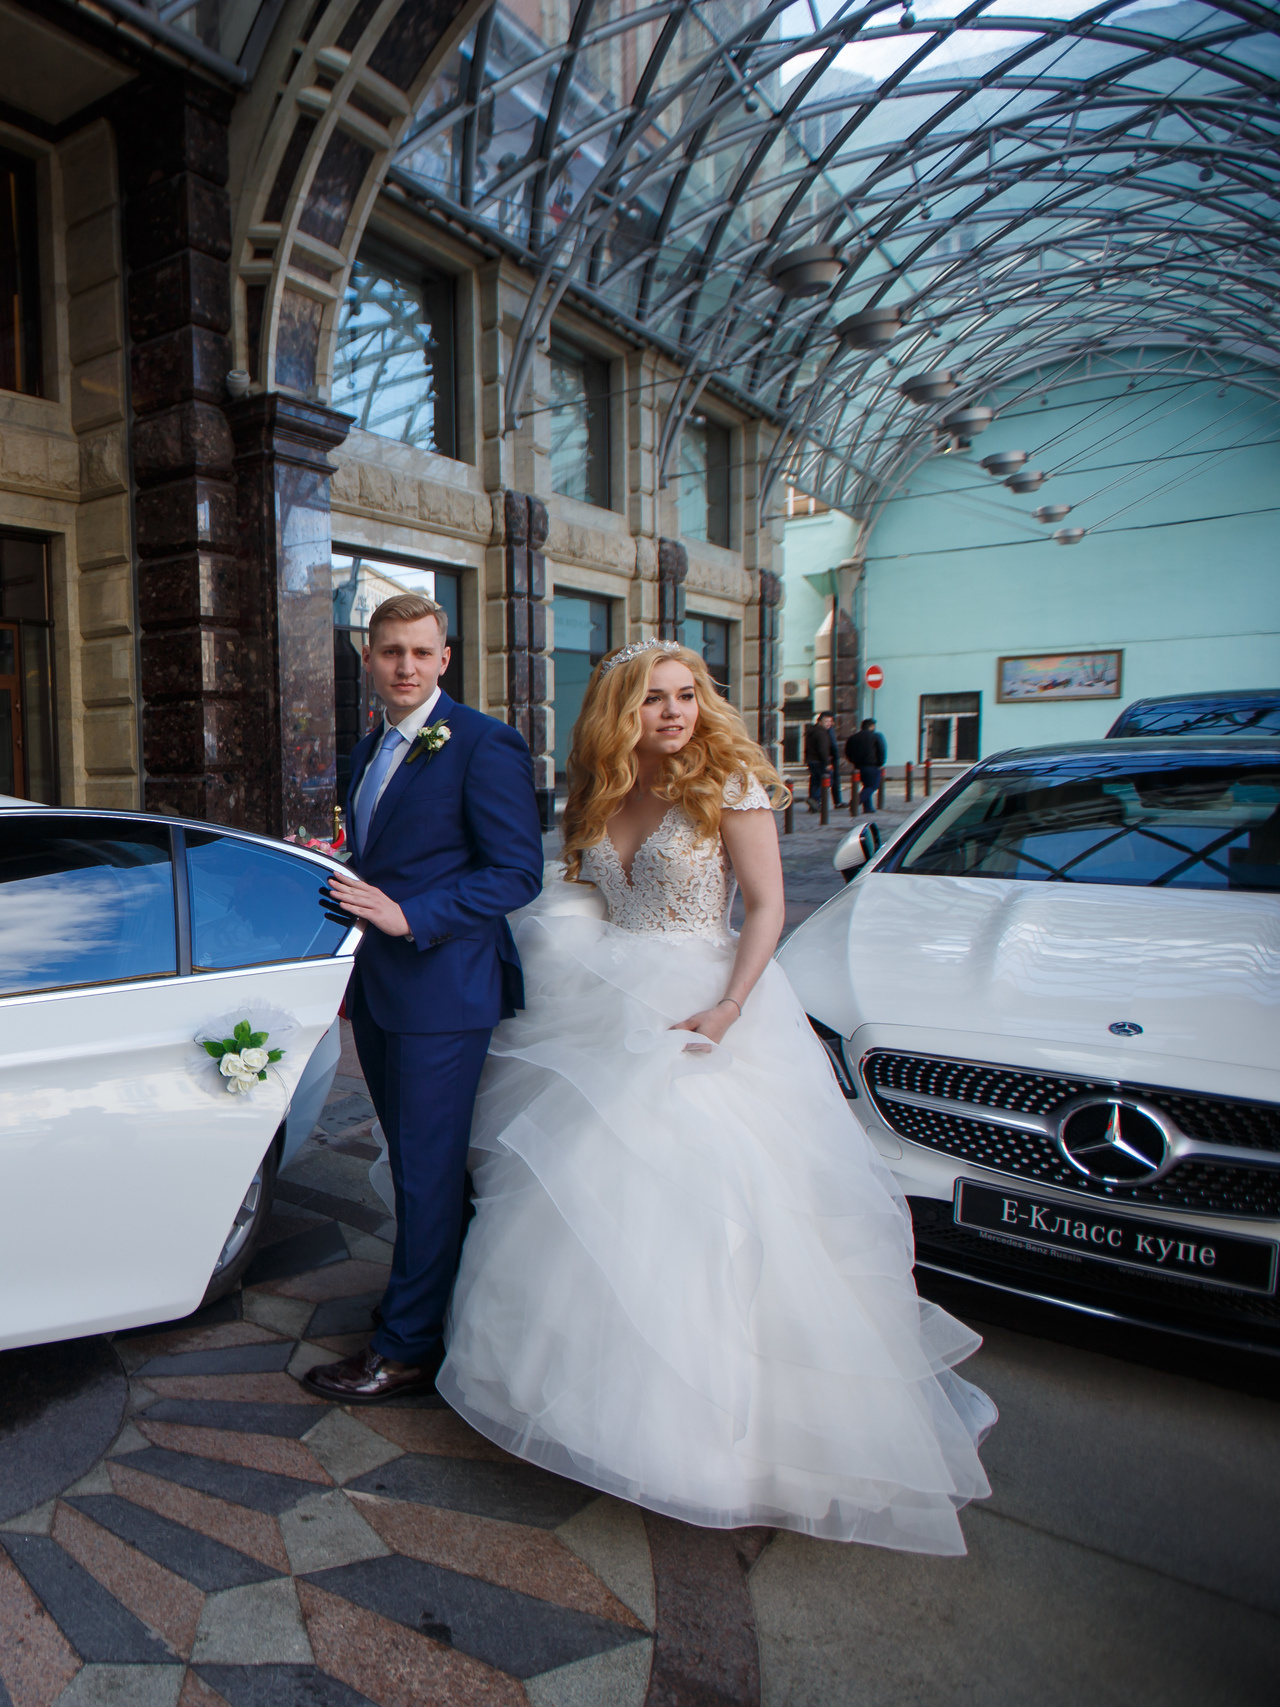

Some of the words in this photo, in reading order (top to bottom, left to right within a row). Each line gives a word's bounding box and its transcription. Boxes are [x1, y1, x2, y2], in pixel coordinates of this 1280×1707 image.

[978, 1230, 1048, 1255] Mercedes-Benz
[1050, 1249, 1082, 1263] Russia
[1135, 1232, 1217, 1266] купе
